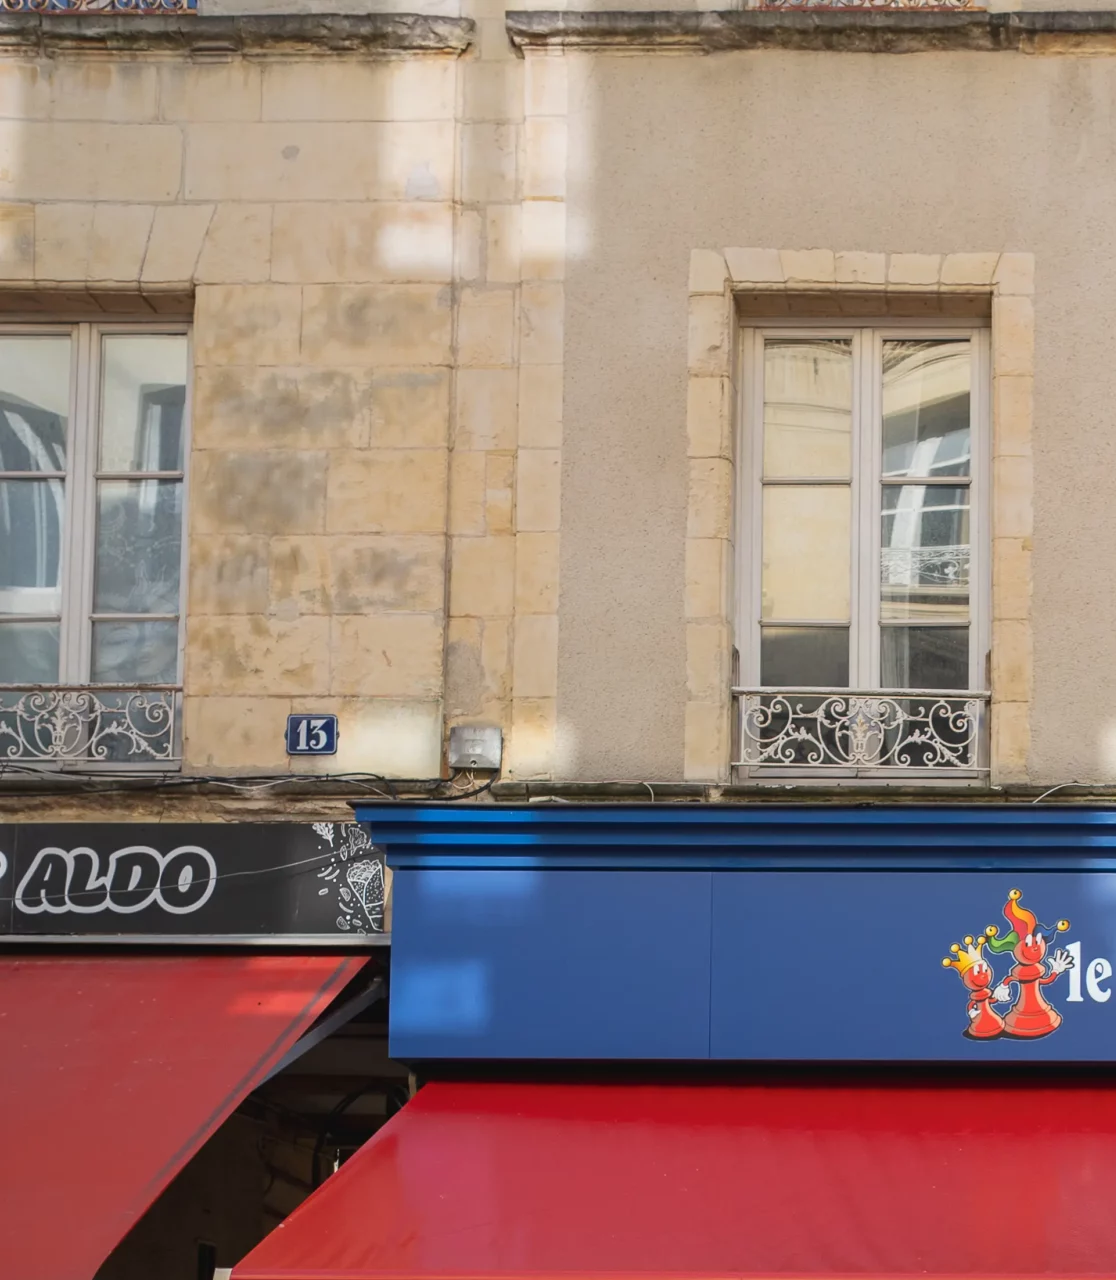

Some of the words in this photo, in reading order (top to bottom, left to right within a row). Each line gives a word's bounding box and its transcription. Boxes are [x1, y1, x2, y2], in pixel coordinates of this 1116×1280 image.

[296, 719, 327, 750] 13
[15, 845, 217, 914] ALDO
[1065, 941, 1113, 1002] le
